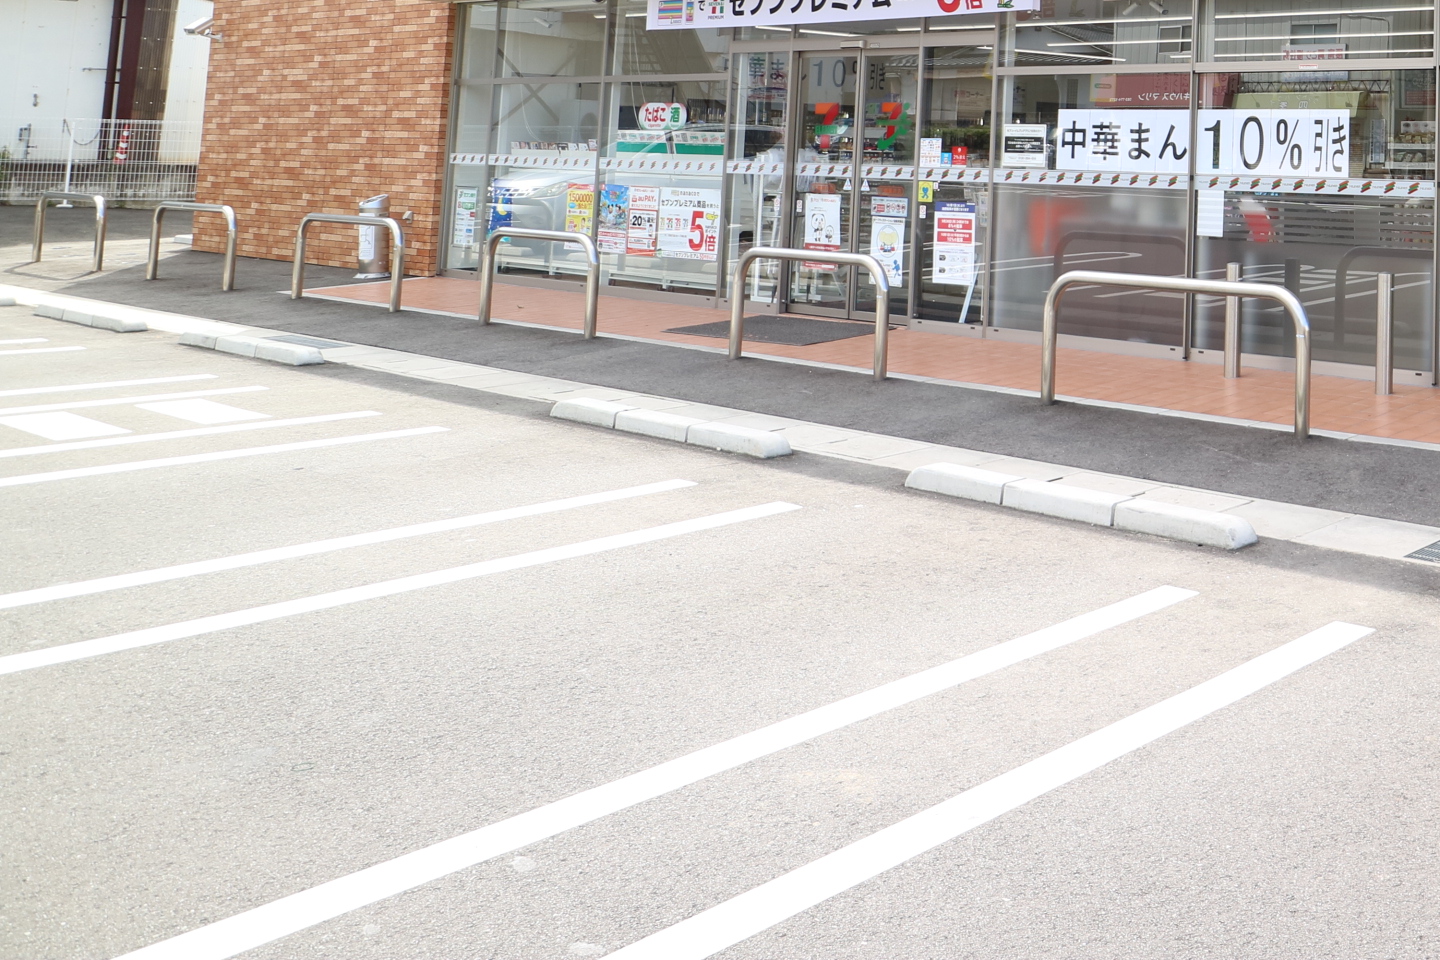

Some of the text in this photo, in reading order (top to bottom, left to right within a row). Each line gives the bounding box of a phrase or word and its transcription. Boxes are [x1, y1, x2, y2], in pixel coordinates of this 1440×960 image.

[644, 106, 681, 123] たばこ 酒
[1061, 115, 1347, 173] 中華まん 10%引き
